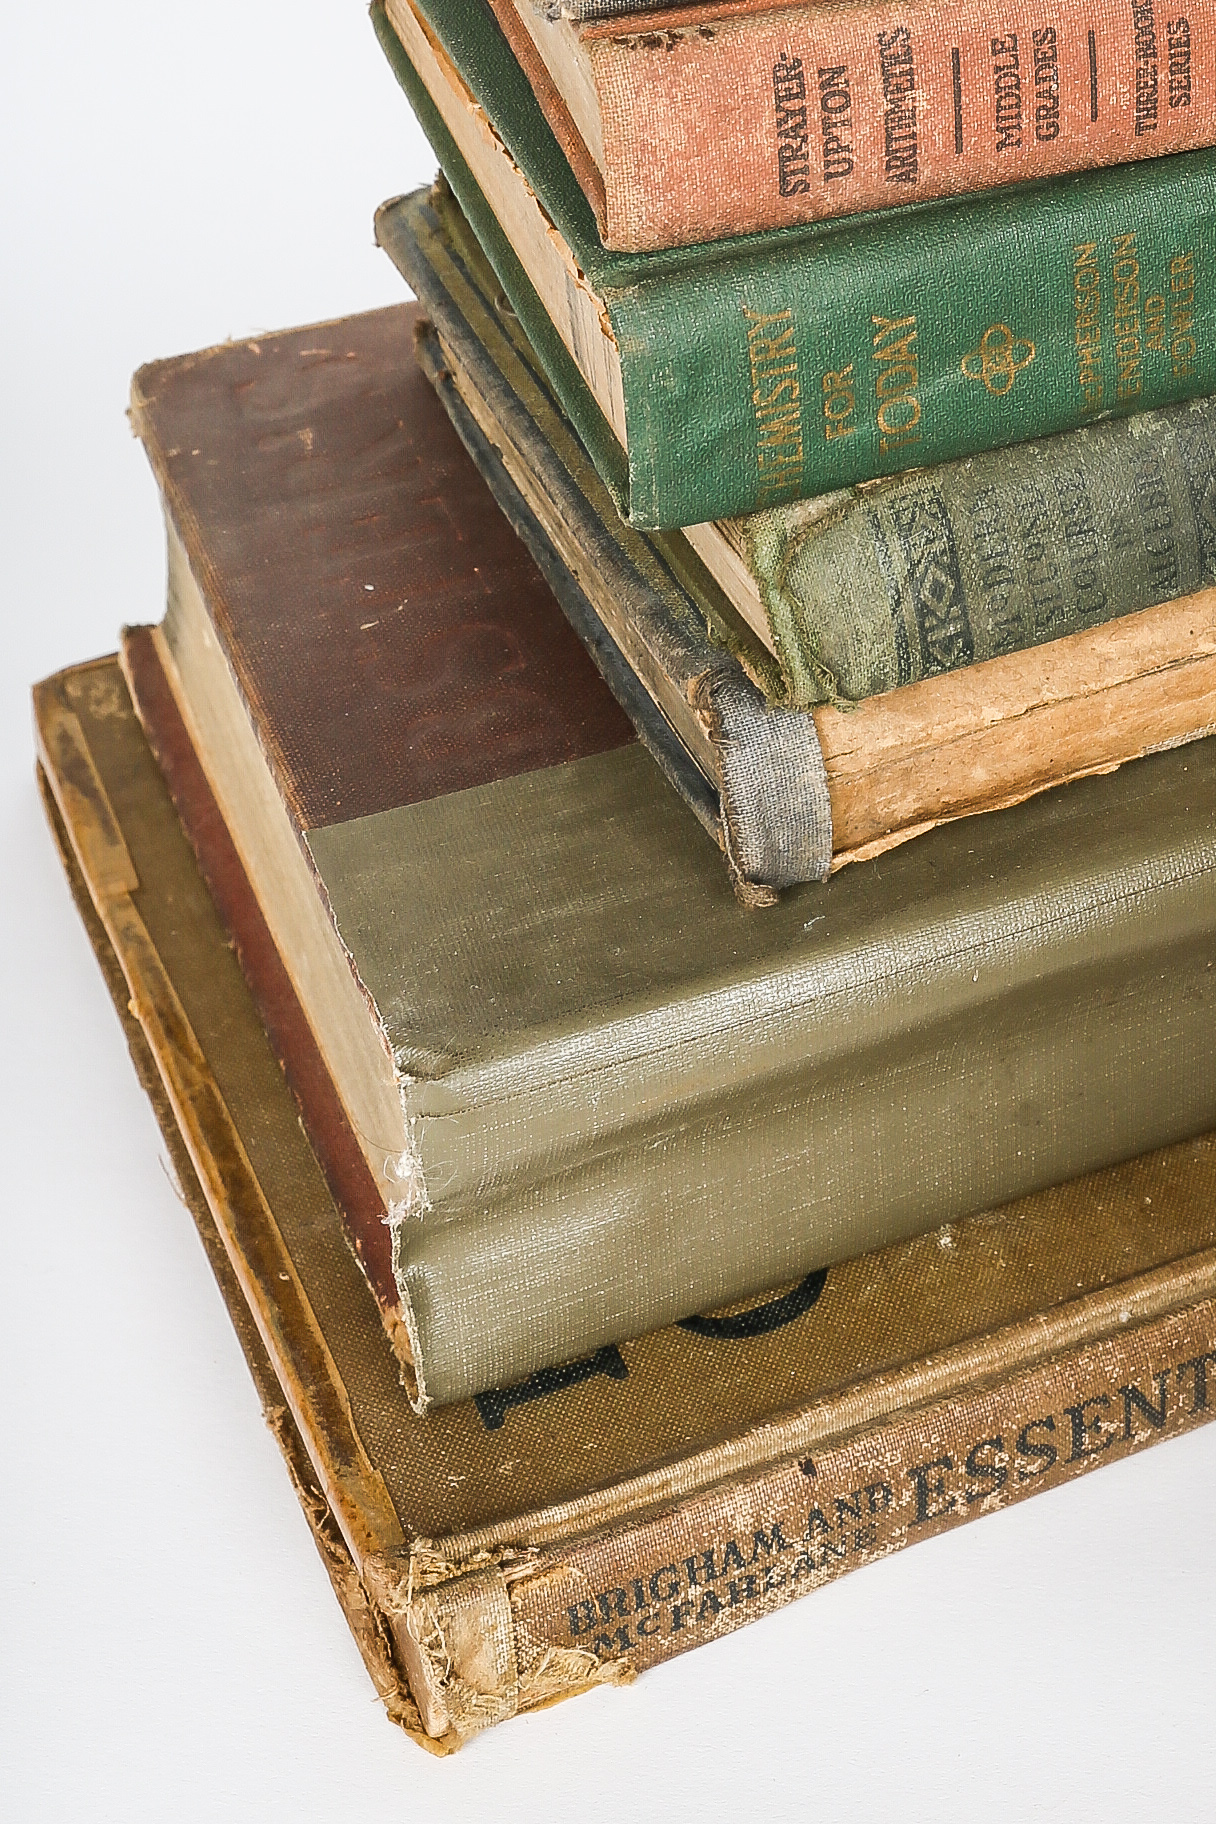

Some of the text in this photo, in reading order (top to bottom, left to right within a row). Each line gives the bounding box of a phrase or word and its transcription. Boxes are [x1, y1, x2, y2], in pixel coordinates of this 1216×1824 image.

[773, 52, 811, 199] STRAYER-
[818, 65, 855, 182] UPTON
[877, 26, 919, 187] ARITHMETICS
[991, 32, 1023, 152] MIDDLE
[1034, 26, 1061, 143] GRADES
[1167, 16, 1193, 109] SERIES
[1073, 241, 1103, 414] cPHERSON
[1111, 232, 1142, 406] ENDERSON
[1144, 293, 1166, 353] AND
[1169, 251, 1196, 378] FOWLER
[822, 363, 854, 441] FOR
[871, 314, 922, 456] TODAY
[567, 1480, 894, 1637] BRIGHAM AND
